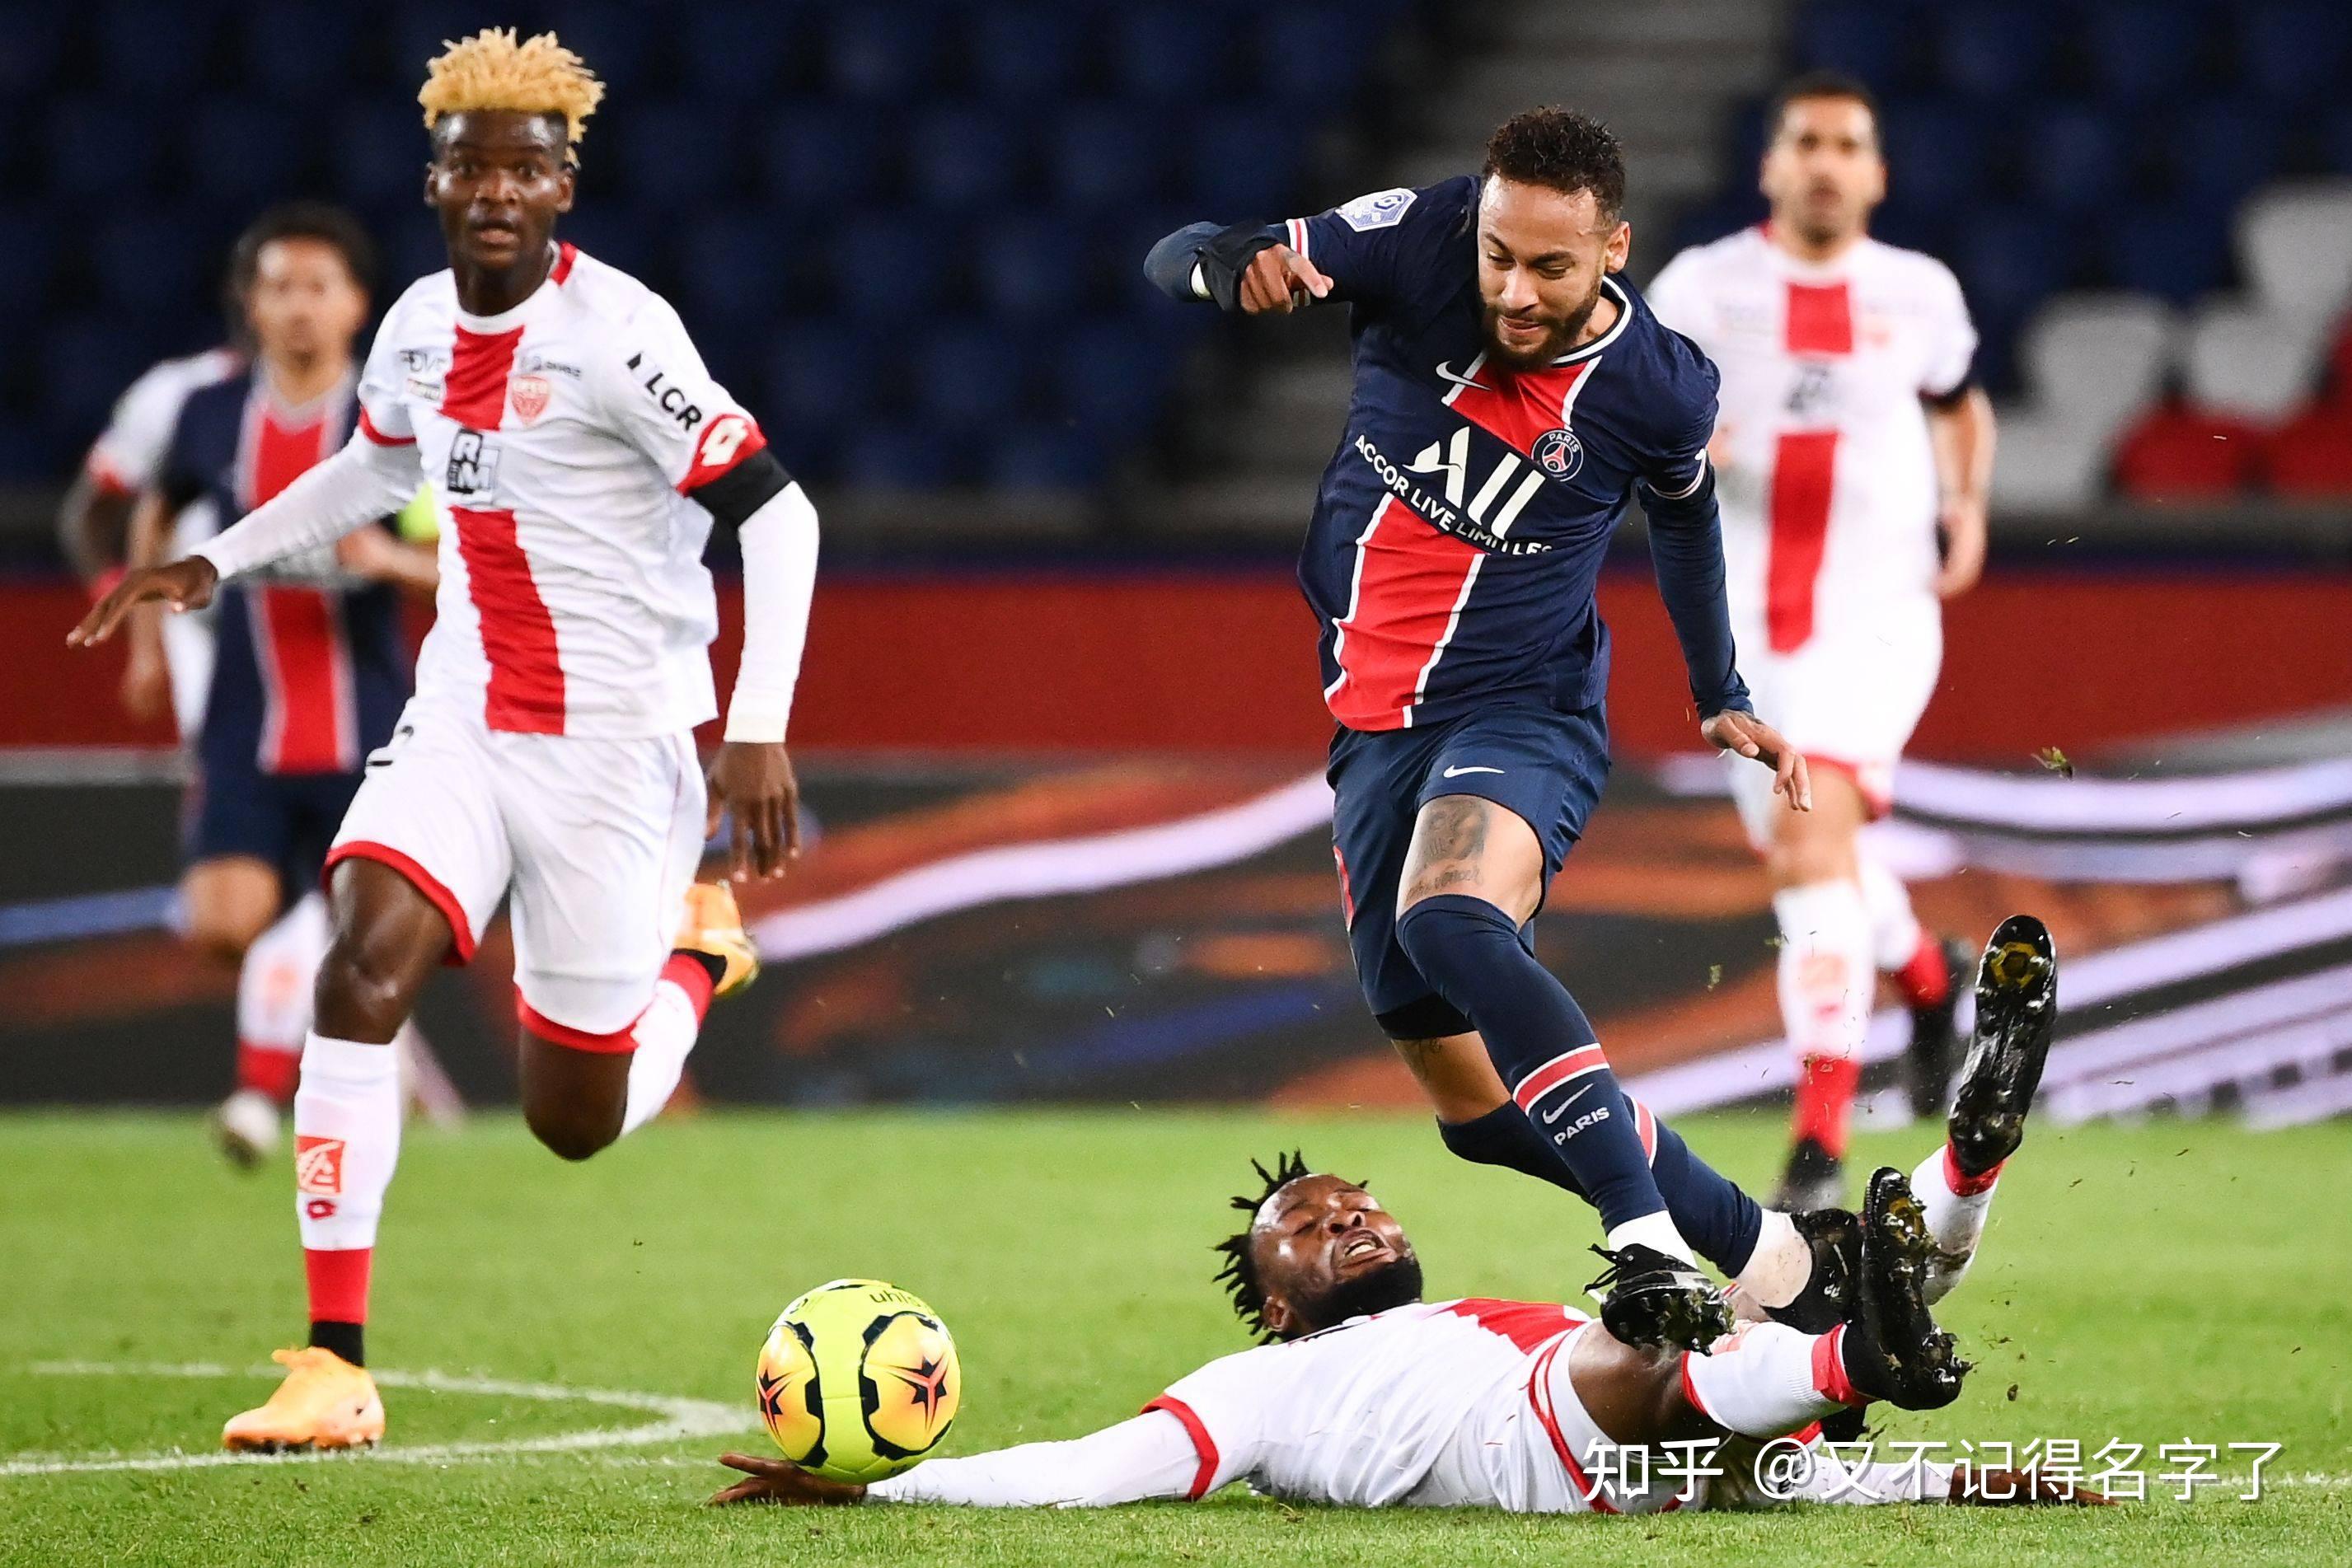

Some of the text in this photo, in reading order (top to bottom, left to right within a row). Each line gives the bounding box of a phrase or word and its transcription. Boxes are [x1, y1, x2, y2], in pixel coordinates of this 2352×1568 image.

[645, 372, 702, 431] LCR
[1548, 433, 1580, 453] PARIS
[1354, 434, 1409, 497] ACCOR
[1410, 488, 1455, 531] LIVE
[1553, 1107, 1609, 1146] PARIS
